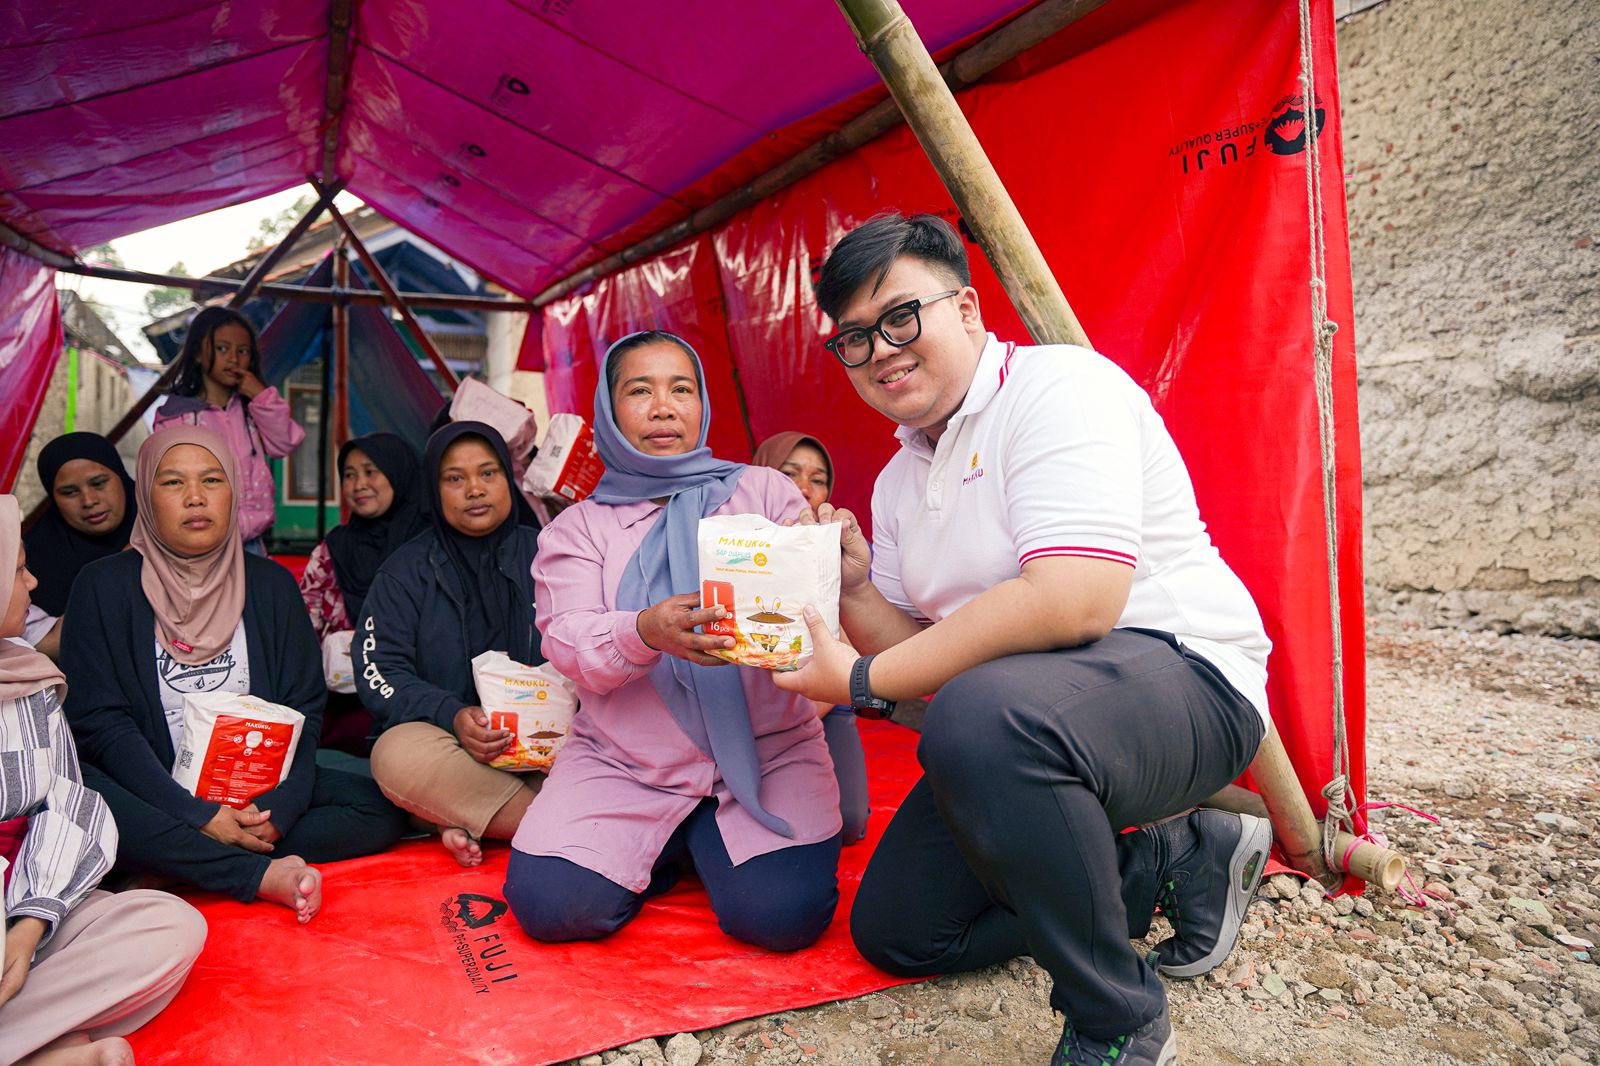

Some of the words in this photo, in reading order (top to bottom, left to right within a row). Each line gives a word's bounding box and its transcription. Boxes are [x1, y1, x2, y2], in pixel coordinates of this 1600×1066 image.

[1168, 132, 1212, 157] QUALITY
[1183, 135, 1257, 174] FUJI
[362, 616, 395, 699] adidas
[501, 715, 510, 730] L
[473, 933, 518, 983] FUJI
